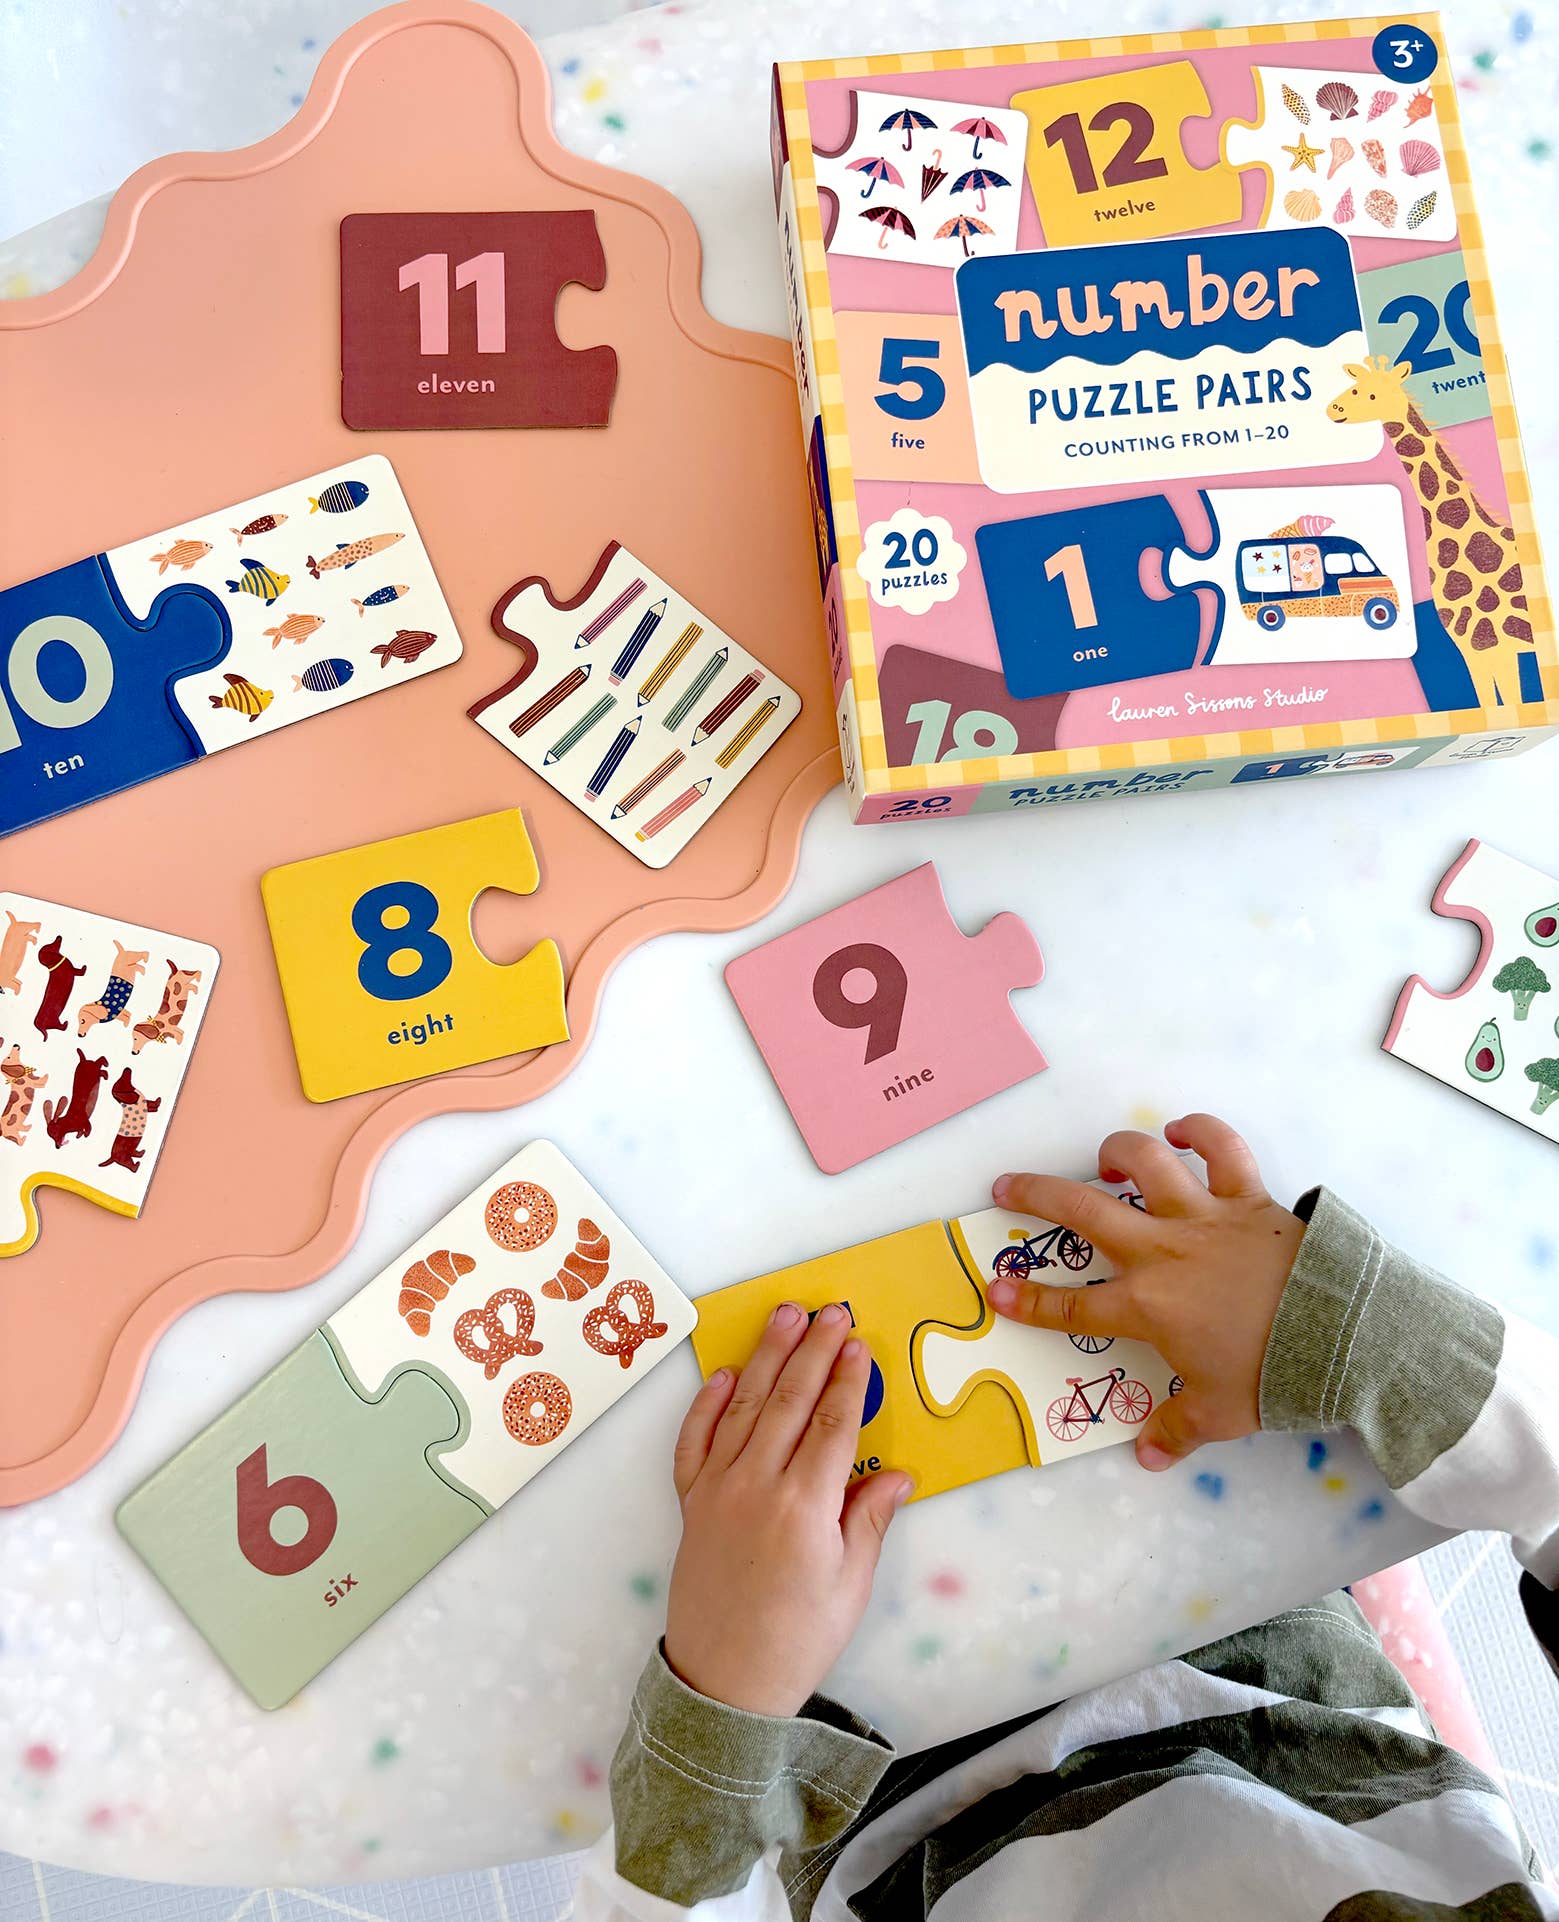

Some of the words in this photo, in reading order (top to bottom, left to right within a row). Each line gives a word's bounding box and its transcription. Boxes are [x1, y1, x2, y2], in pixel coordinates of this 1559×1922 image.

[1389, 40, 1424, 68] 3+
[1043, 101, 1169, 195] 12
[1093, 199, 1156, 222] twelve
[398, 251, 507, 355] 11
[994, 254, 1321, 346] number
[1378, 279, 1482, 375] 20
[417, 372, 497, 394] eleven
[873, 337, 947, 421] 5
[1028, 378, 1179, 425] PUZZLE
[1196, 365, 1313, 410] PAIRS
[1431, 370, 1487, 394] twent
[890, 431, 926, 450] five
[1064, 433, 1176, 458] COUNTING
[1181, 429, 1240, 449] FROM
[882, 528, 939, 570] 20
[881, 570, 949, 596] puzzles
[1043, 544, 1099, 630] 1
[1072, 646, 1109, 662] one
[1183, 691, 1258, 715] Sissons
[1262, 685, 1329, 708] Studio
[42, 754, 86, 779] ten
[1008, 768, 1215, 800] number
[1013, 788, 1103, 807] PUZZLE
[1111, 781, 1184, 797] PAIRS
[879, 806, 954, 820] puzzles
[887, 795, 953, 814] 20
[351, 881, 453, 1001] 8
[812, 943, 908, 1066] 9
[387, 1013, 454, 1045] eight
[882, 1068, 935, 1102] nine
[848, 1456, 882, 1479] ve
[236, 1442, 338, 1576] 6
[323, 1572, 360, 1608] six
